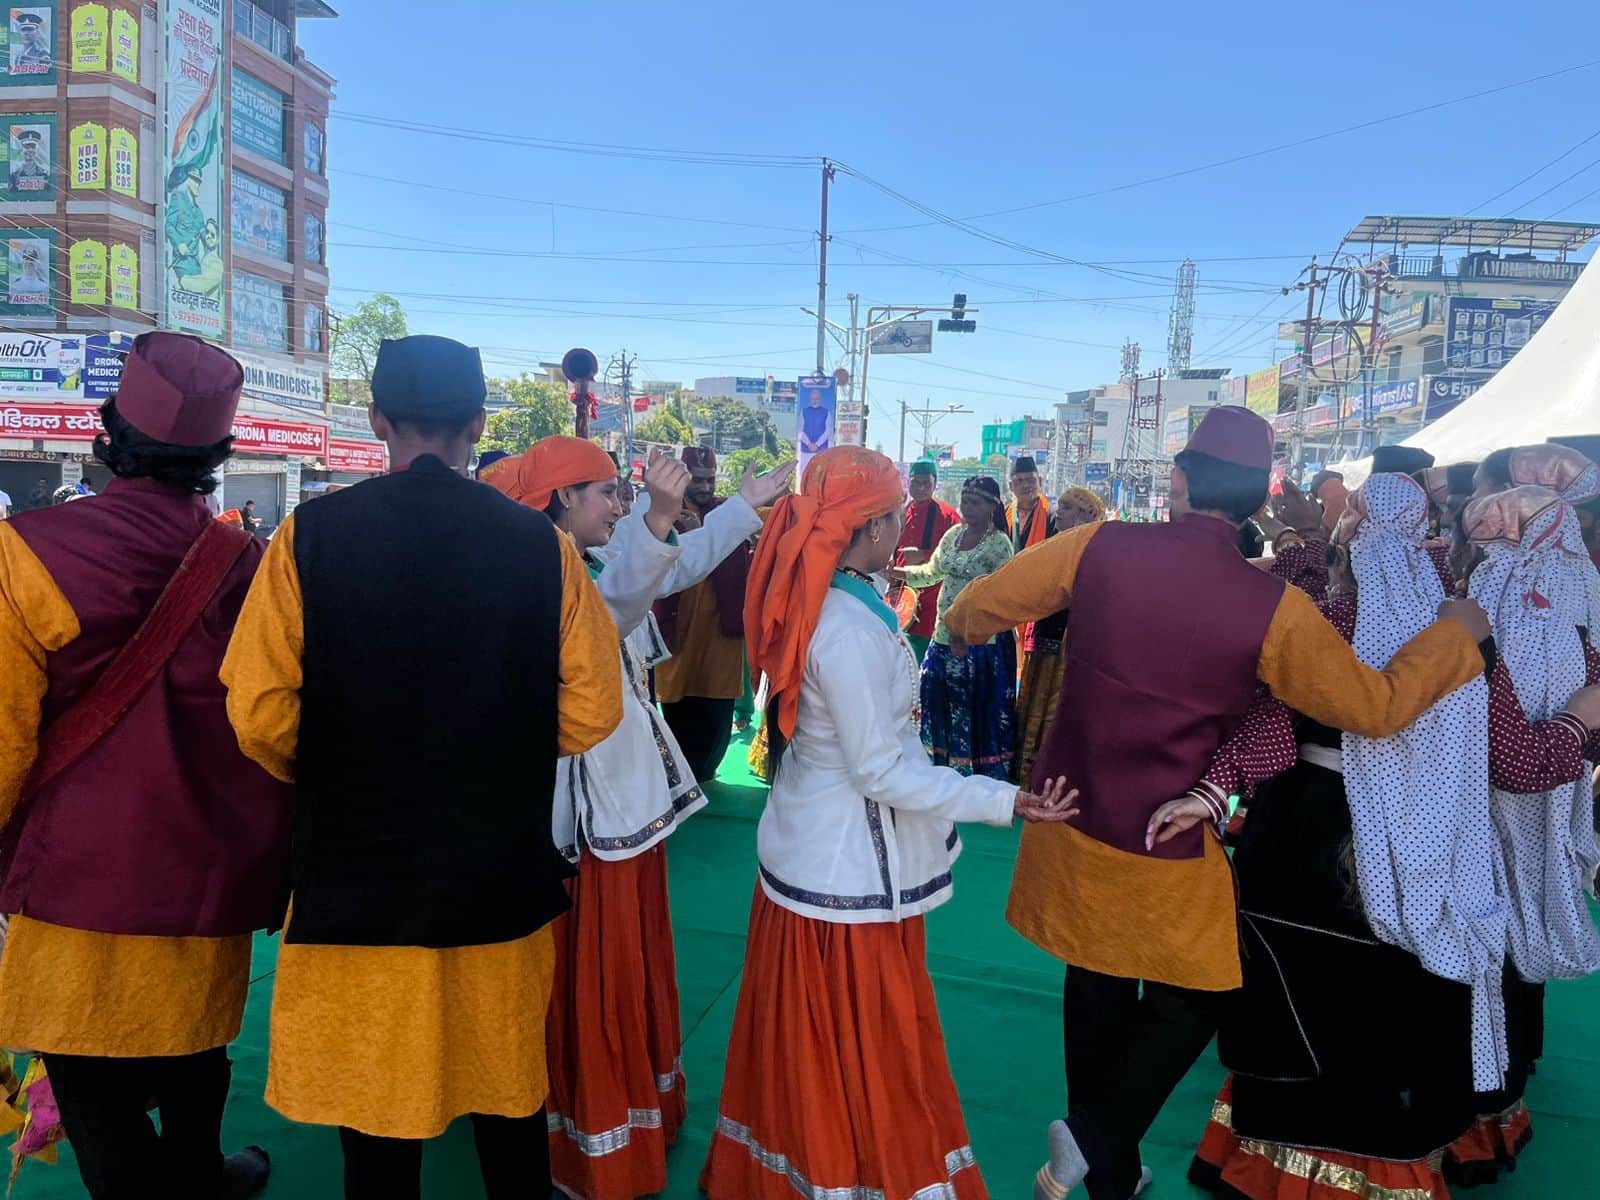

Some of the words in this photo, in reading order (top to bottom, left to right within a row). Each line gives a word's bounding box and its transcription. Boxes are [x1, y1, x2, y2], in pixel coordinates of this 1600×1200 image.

[78, 144, 98, 157] NDA
[116, 150, 131, 162] NDA
[78, 157, 98, 170] SSB
[116, 163, 131, 175] SSB
[78, 170, 98, 183] CDS
[116, 175, 131, 188] CDS
[0, 340, 50, 358] lthOK
[88, 368, 119, 377] MEDICO
[245, 366, 264, 386] ONA
[266, 371, 312, 396] MEDICOSE
[268, 428, 314, 446] MEDICOSE
